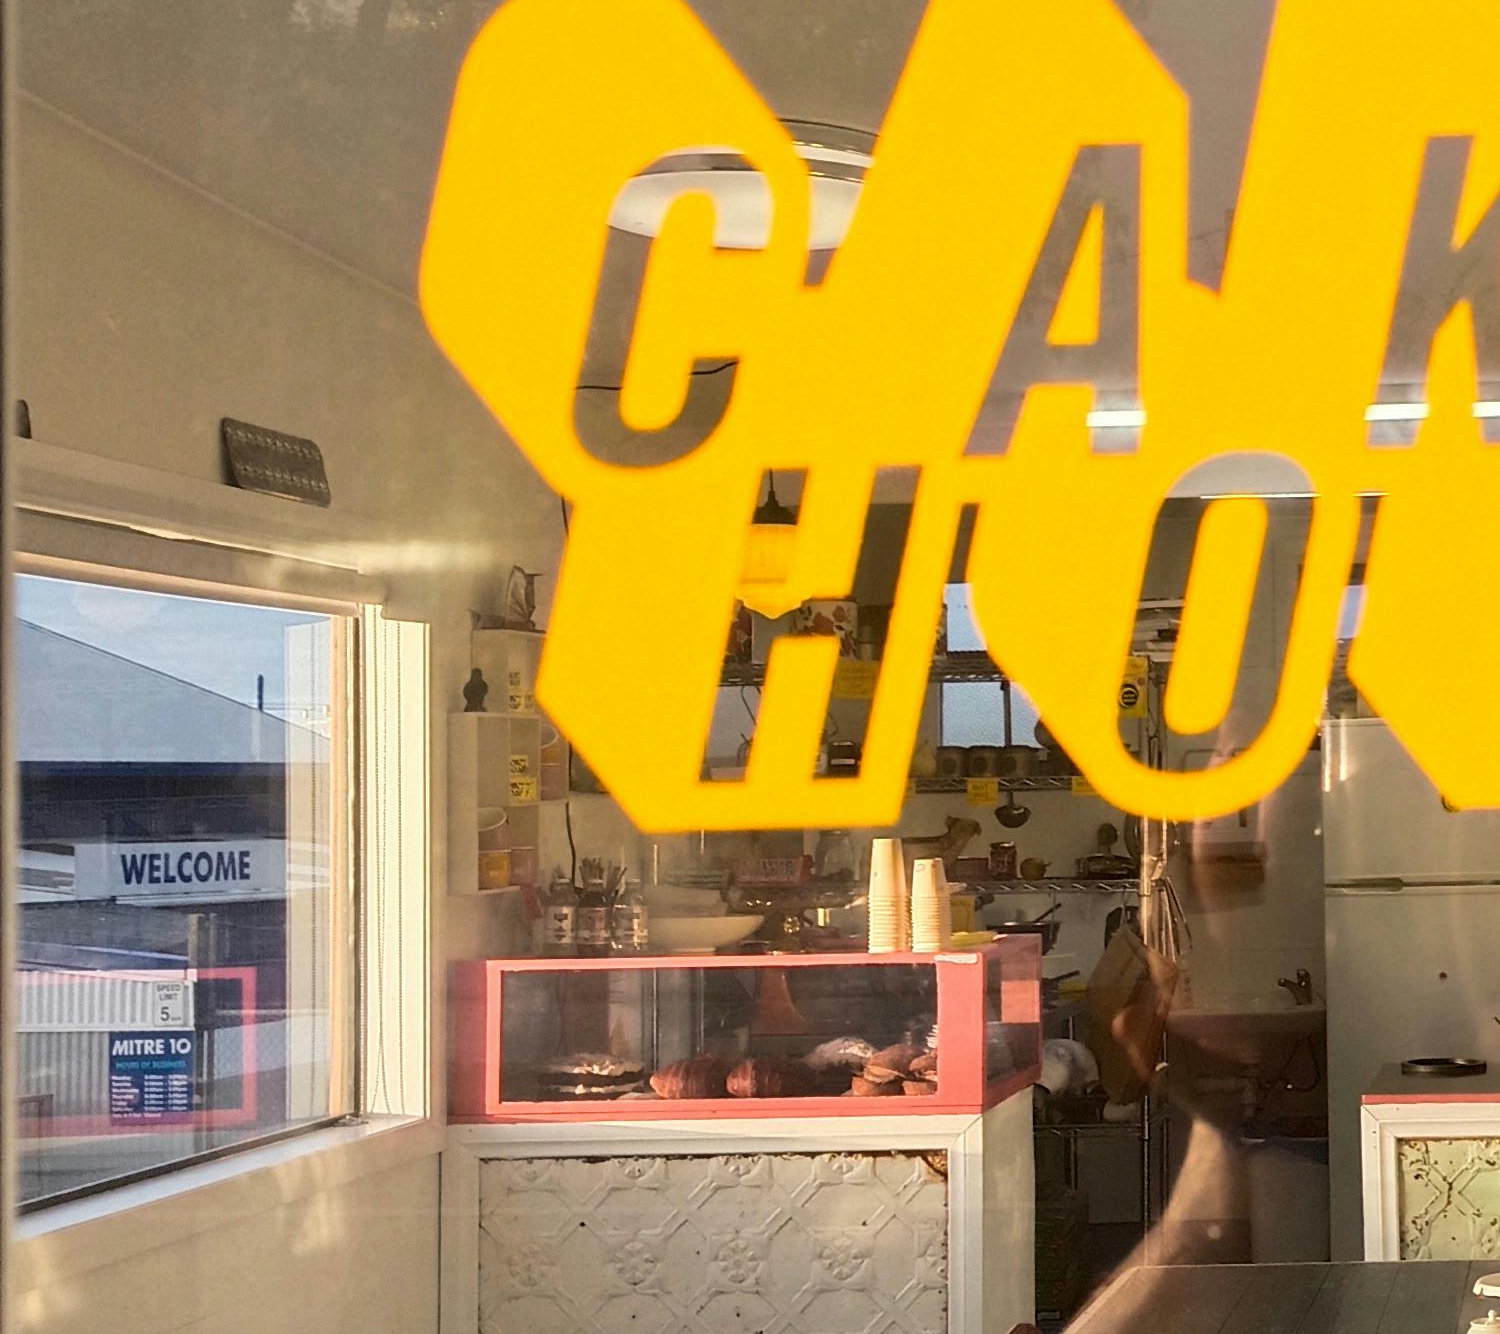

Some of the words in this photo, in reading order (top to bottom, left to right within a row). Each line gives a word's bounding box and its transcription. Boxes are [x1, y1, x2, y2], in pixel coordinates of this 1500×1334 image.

[120, 850, 251, 885] WELCOME
[160, 1006, 170, 1022] 5
[112, 1038, 165, 1056] MITRE
[169, 1037, 191, 1055] 10
